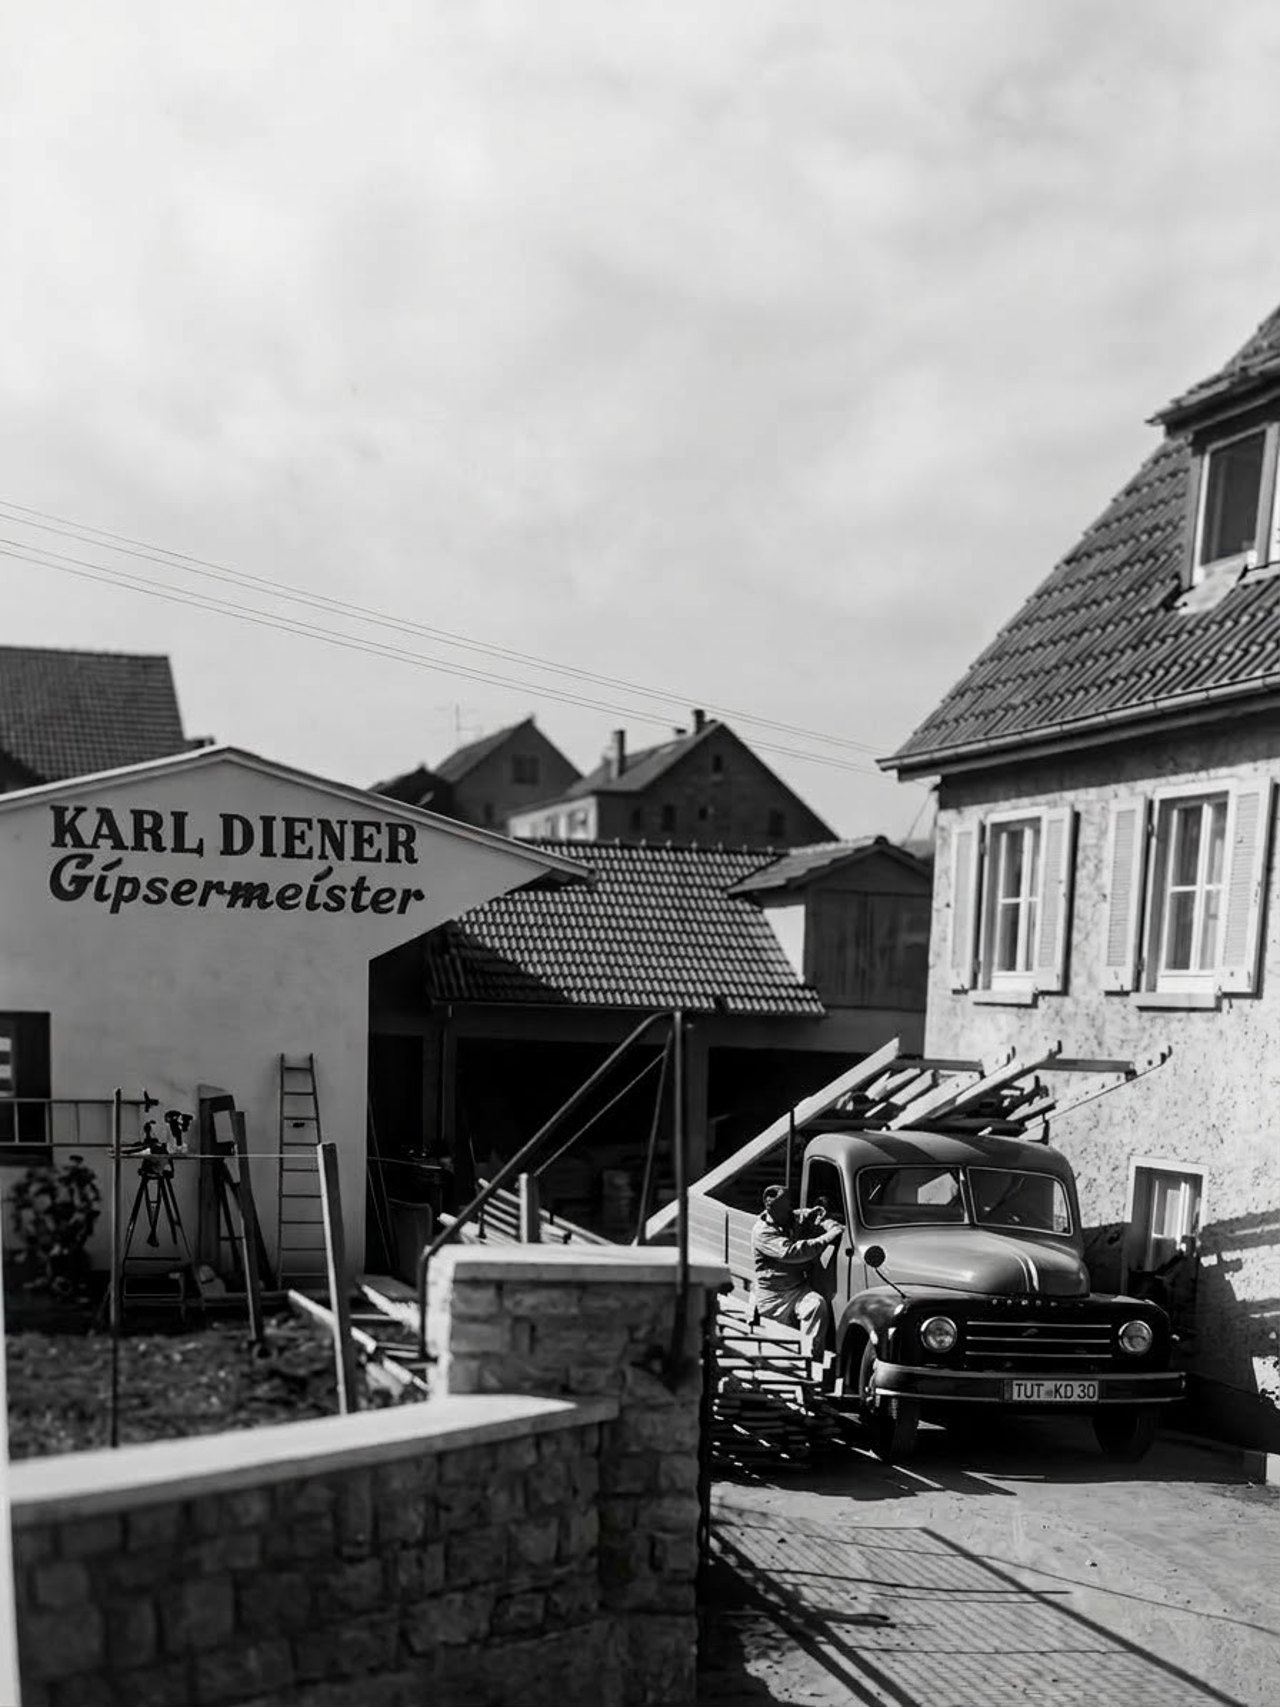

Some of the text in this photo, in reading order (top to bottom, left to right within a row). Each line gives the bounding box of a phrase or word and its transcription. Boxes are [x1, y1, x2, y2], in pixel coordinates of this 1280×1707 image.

[50, 805, 418, 864] KARL DIENER
[49, 853, 425, 914] Gipsermeister
[1015, 1383, 1045, 1399] TUT
